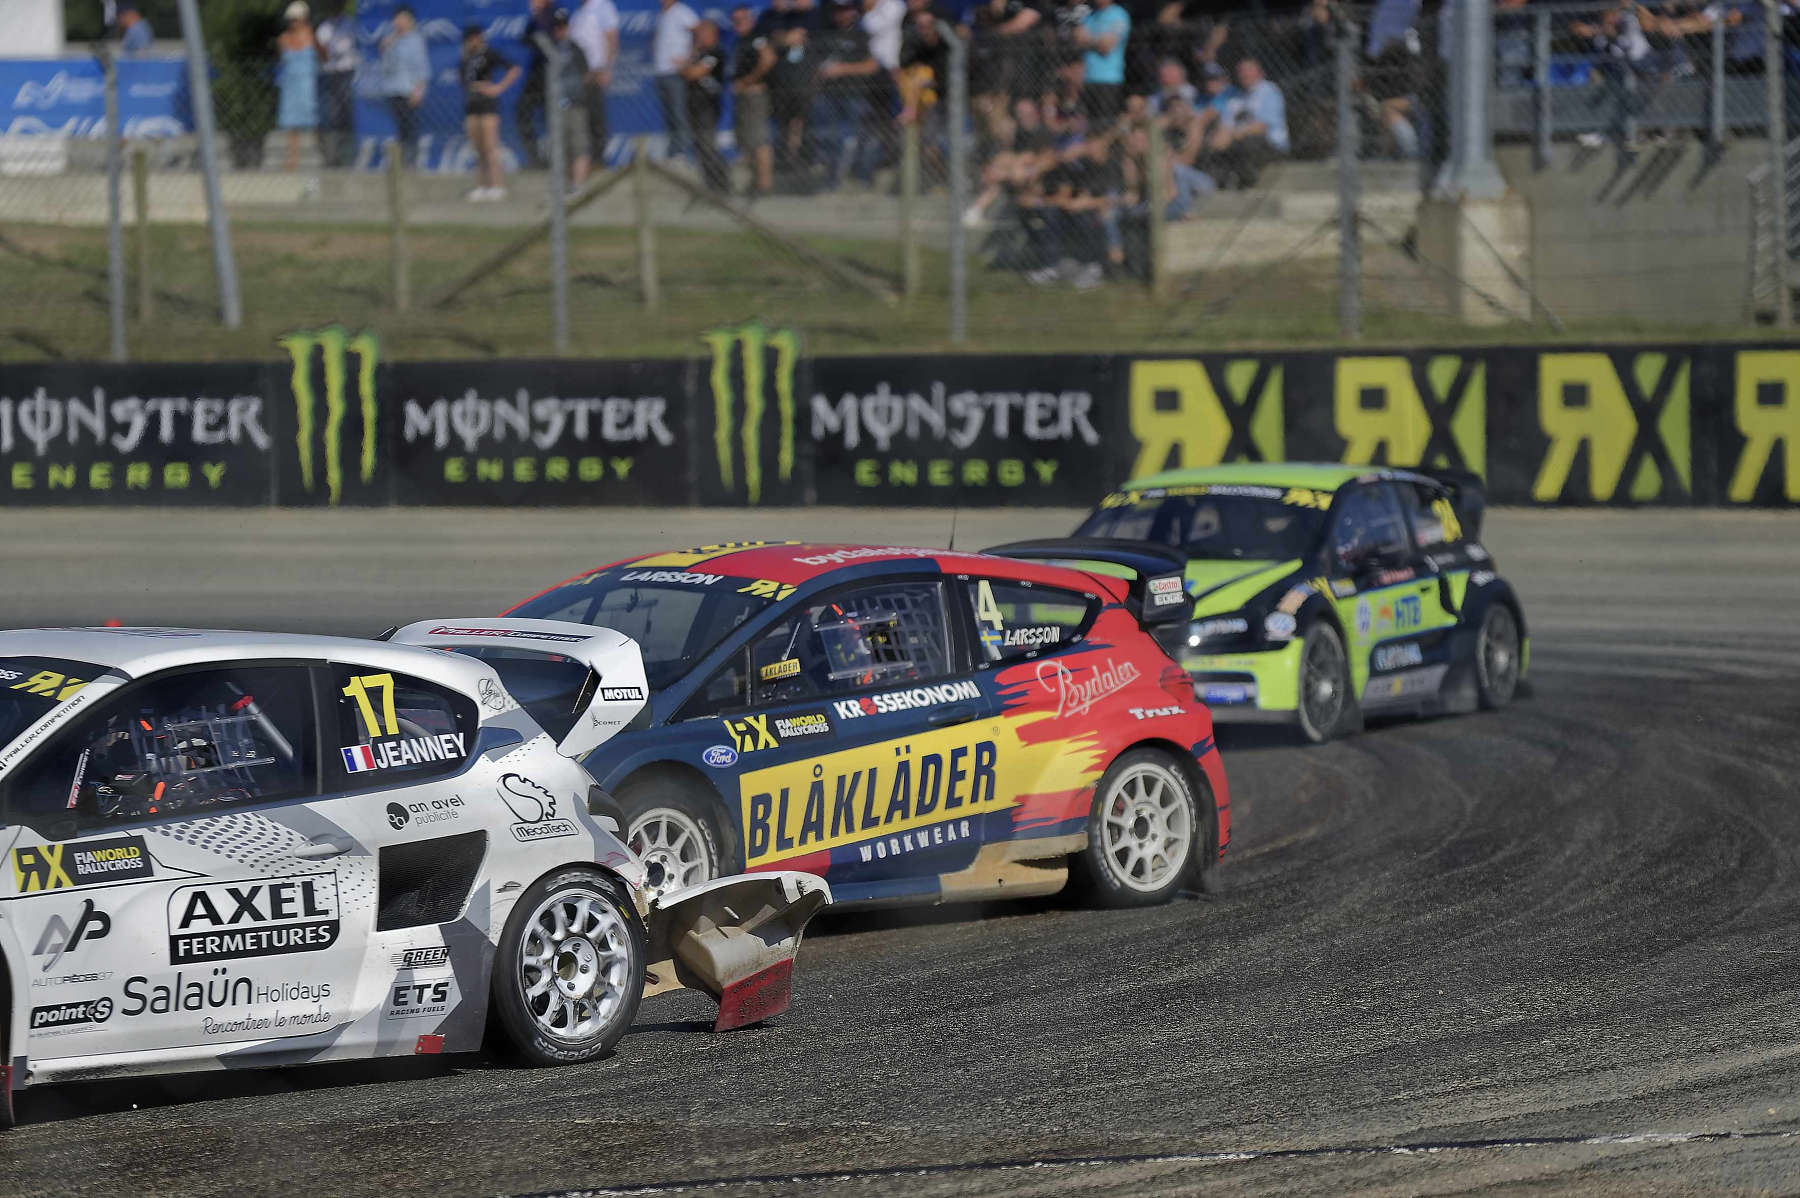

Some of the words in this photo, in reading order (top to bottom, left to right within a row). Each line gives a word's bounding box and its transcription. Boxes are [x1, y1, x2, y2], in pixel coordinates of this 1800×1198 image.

[404, 387, 673, 451] MONSTER
[811, 382, 1099, 451] MONSTER
[11, 461, 226, 489] ENERGY
[444, 456, 634, 483] ENERGY
[854, 458, 1059, 487] ENERGY
[620, 571, 724, 585] LARSSON
[977, 579, 1004, 631] 4
[1004, 626, 1060, 646] LARSSON
[603, 688, 643, 699] MOTUL
[1036, 658, 1141, 719] Bydalen
[342, 673, 399, 737] 17
[1129, 706, 1187, 720] Trux
[780, 723, 830, 738] RALLYCROSS
[376, 733, 467, 769] JEANNEY
[709, 747, 732, 764] Ford
[431, 794, 465, 810] avel
[748, 741, 998, 860] BLÅKLÄDER
[415, 808, 459, 827] publicité
[859, 819, 970, 863] WORKWEAR
[77, 857, 144, 875] RALLYCROSS
[178, 880, 329, 929] AXEL
[178, 925, 330, 957] FERMETURES
[403, 949, 449, 962] GREEN
[121, 967, 252, 1016] Salaün
[256, 981, 331, 1004] Holidays
[393, 982, 450, 1006] ETS
[203, 1013, 271, 1035] Rencontrer
[274, 1010, 287, 1028] le
[289, 1005, 331, 1024] monde
[389, 1007, 420, 1016] RACING
